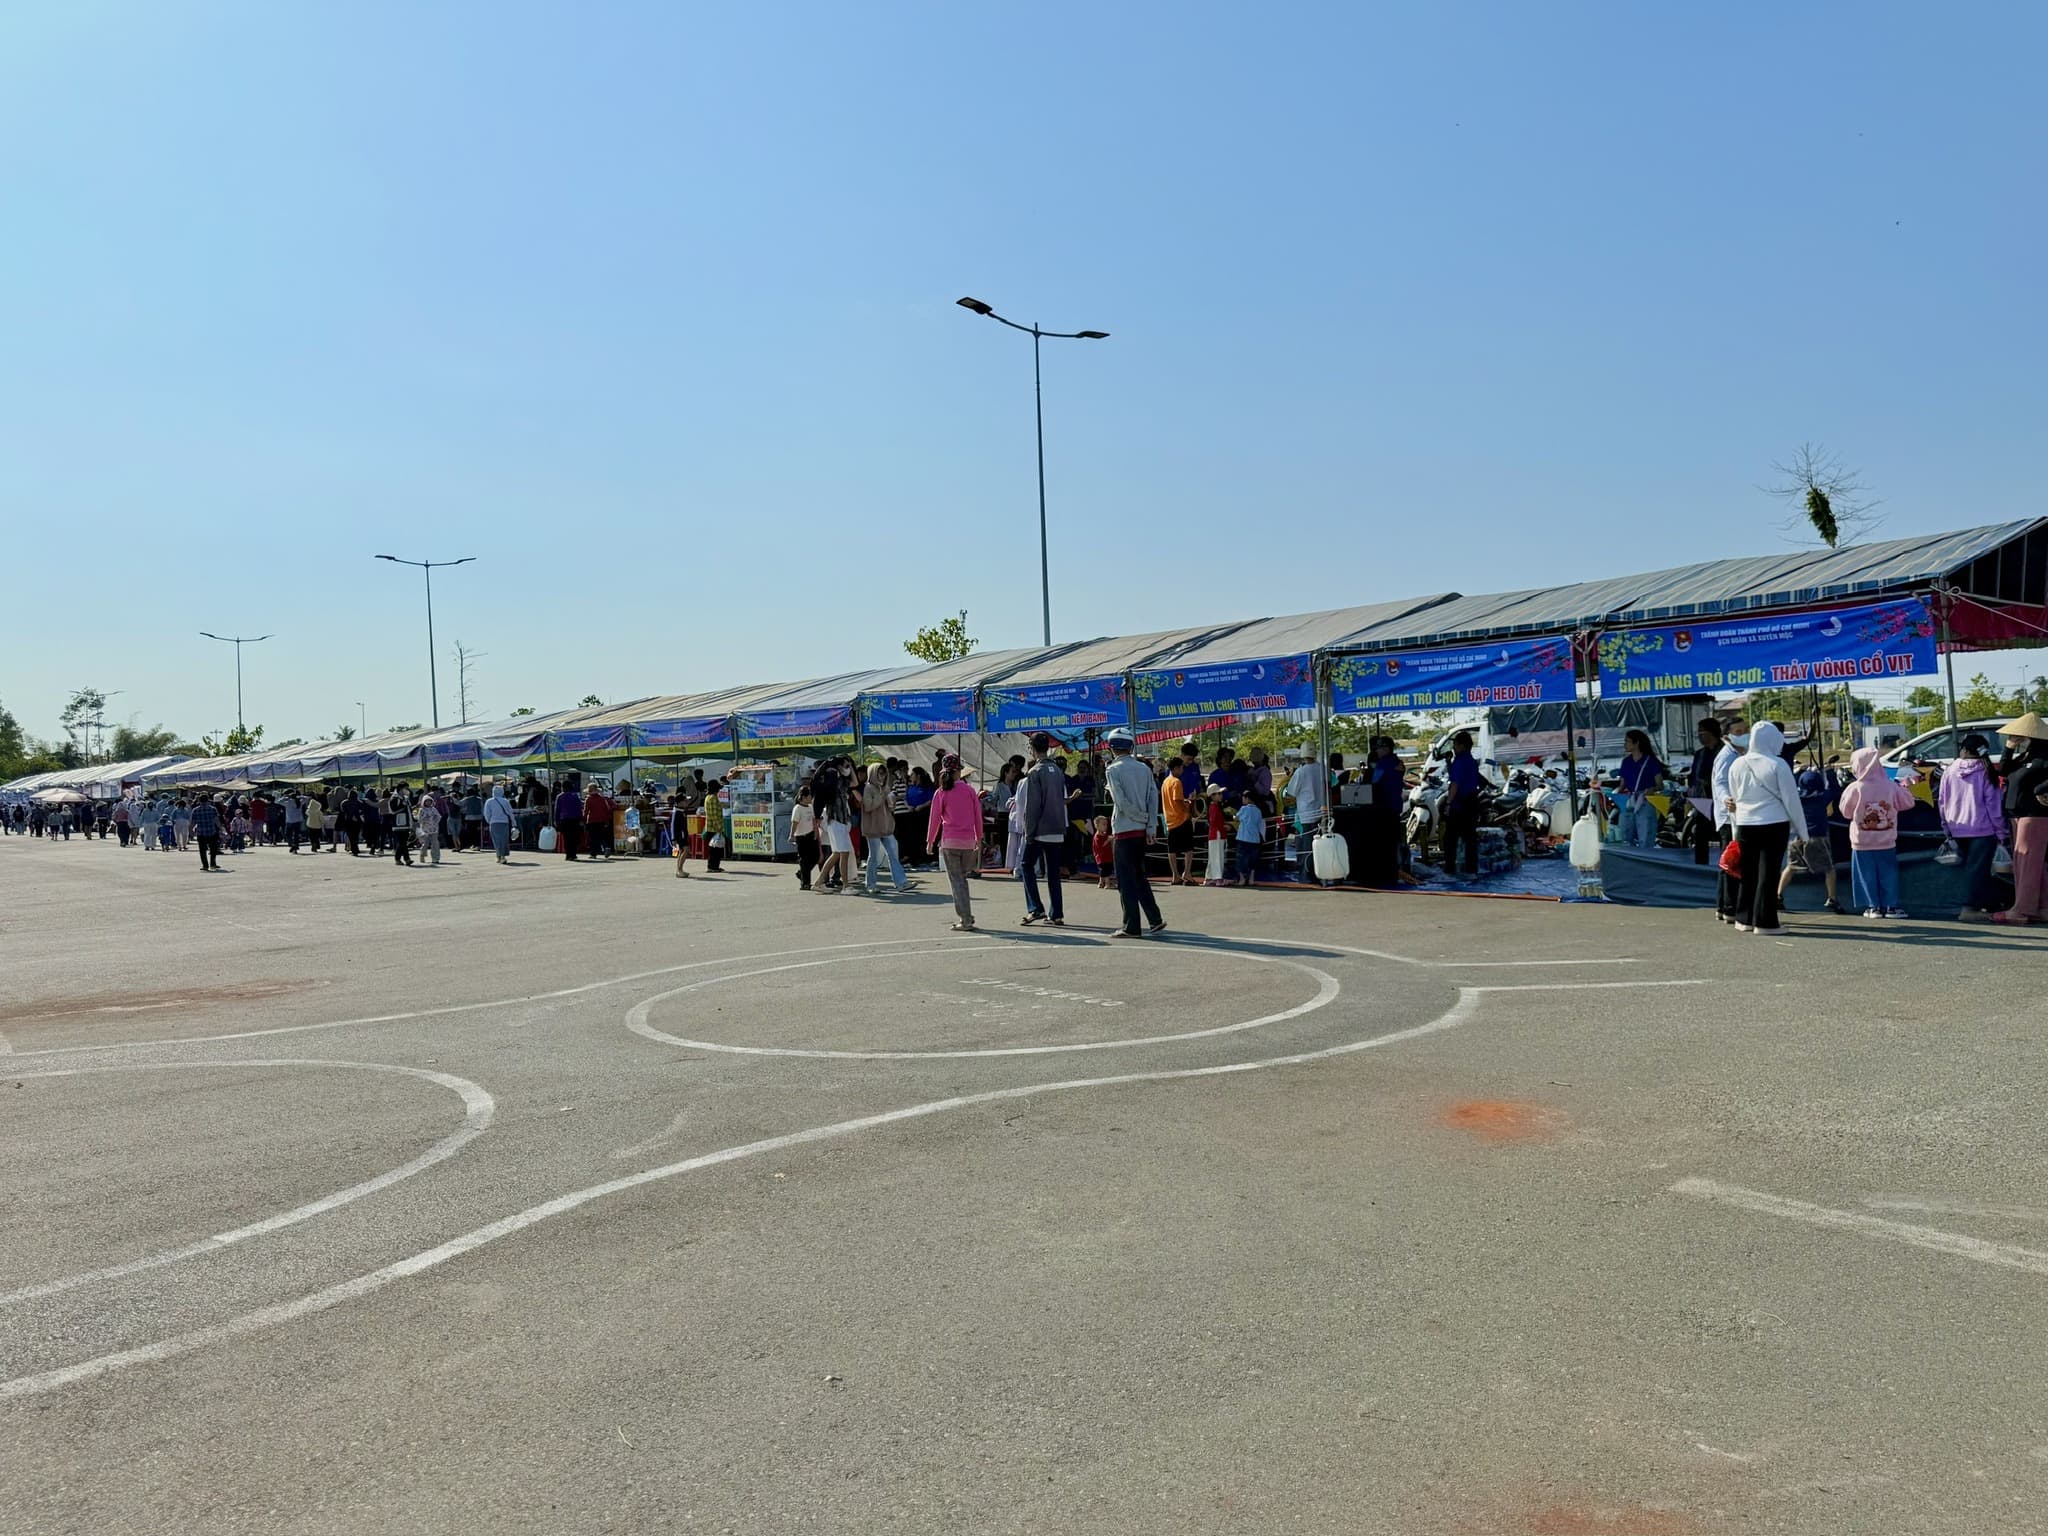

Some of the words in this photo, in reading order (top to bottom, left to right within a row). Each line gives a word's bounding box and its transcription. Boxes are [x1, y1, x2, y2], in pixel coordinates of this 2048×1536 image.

[1619, 679, 1650, 694] GIAN
[1654, 673, 1691, 690] HÀNG
[1697, 668, 1722, 688] TRÒ
[1727, 670, 1766, 685] CHƠI:
[1771, 659, 1809, 682] THẢY
[1813, 657, 1855, 679] VÒNG
[1860, 650, 1883, 675] CỔ
[1887, 654, 1913, 676] VỊT
[1159, 705, 1177, 716] GIAN
[1178, 702, 1198, 714] HÀNG
[1200, 699, 1215, 712] TRÒ
[1216, 699, 1238, 711] CHƠI:
[1239, 693, 1261, 711] THẢY
[1263, 692, 1287, 708] VÒNG
[1356, 696, 1379, 709] GIAN
[1382, 693, 1410, 708] HÀNG
[1413, 689, 1432, 705] TRÒ
[1435, 690, 1464, 704] CHƠI:
[1467, 687, 1490, 706] ĐẬP
[1493, 686, 1515, 701] HEO
[1519, 679, 1542, 699] ĐẤT
[1005, 719, 1019, 729] GIAN
[1021, 717, 1037, 728] HÀNG
[1039, 715, 1051, 727] TRÒ
